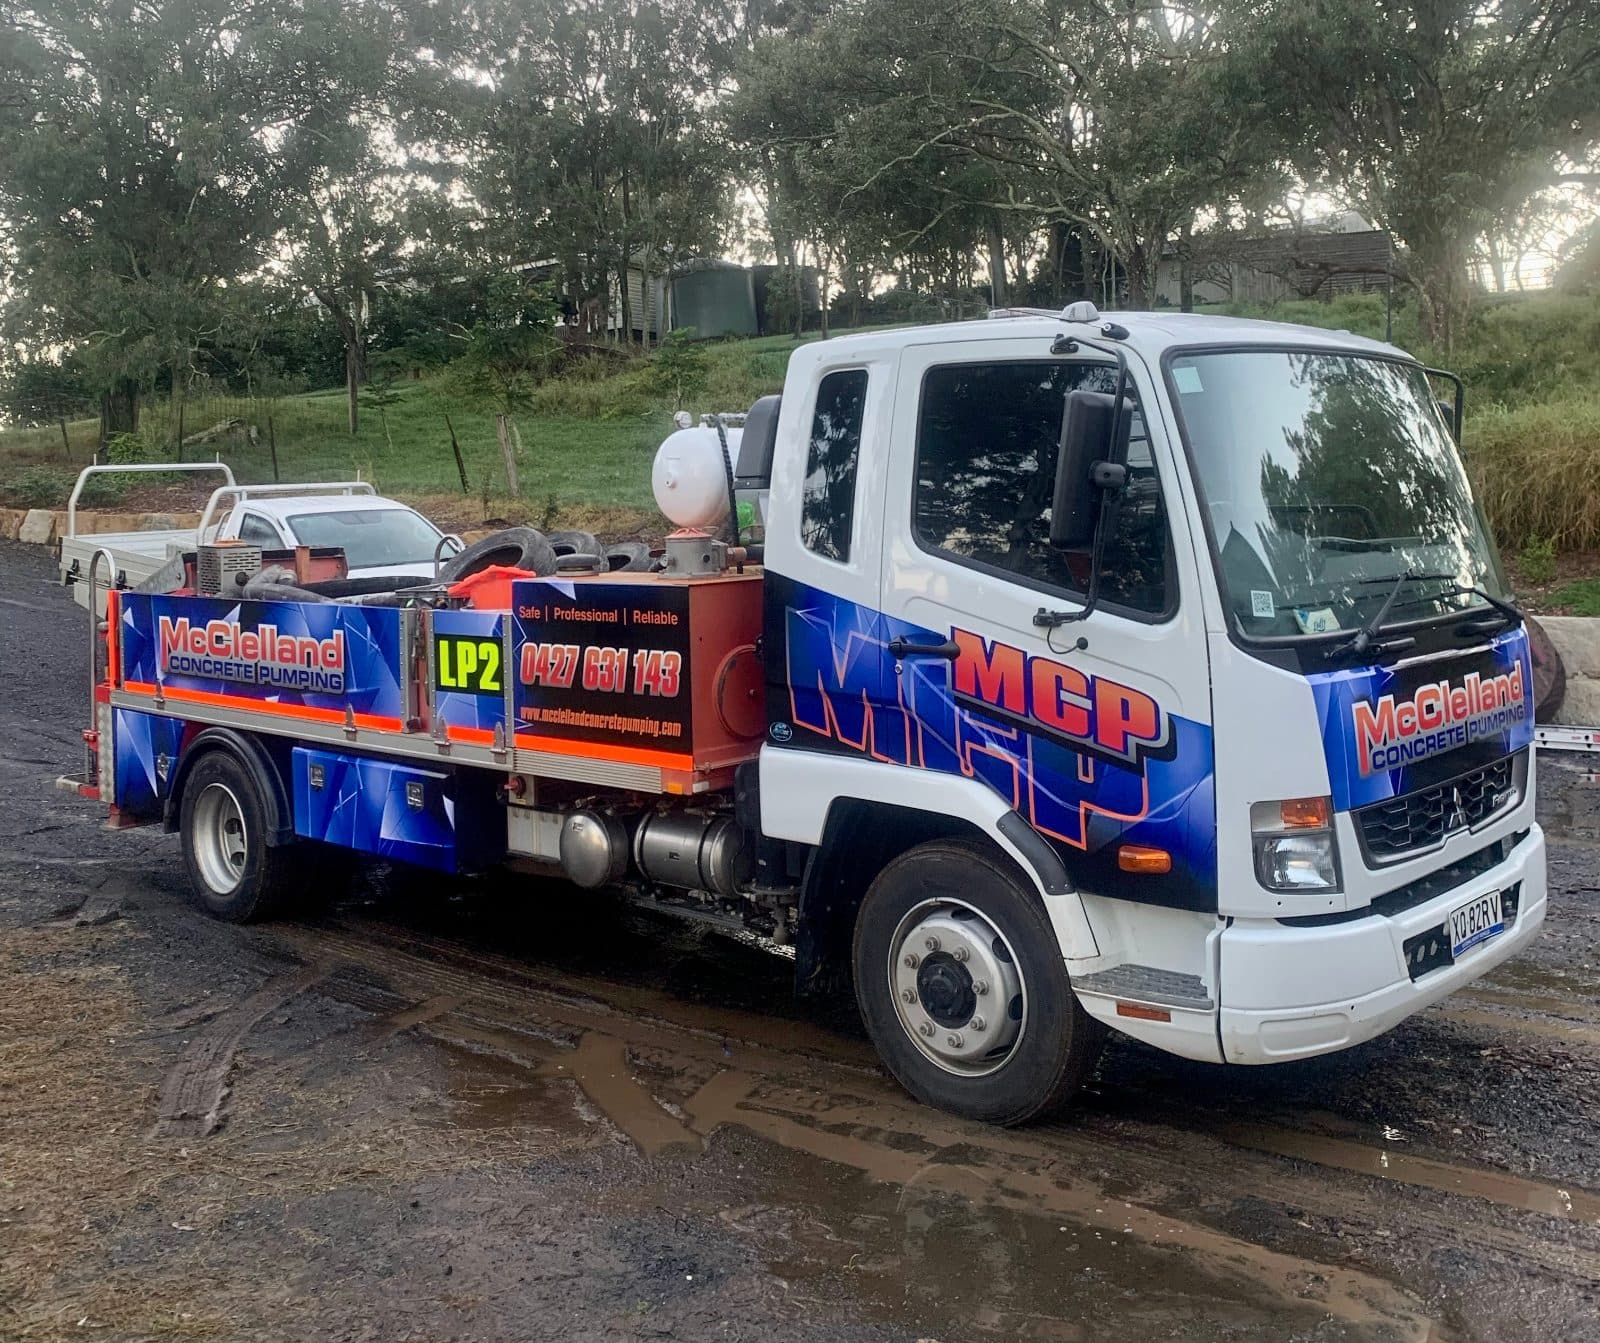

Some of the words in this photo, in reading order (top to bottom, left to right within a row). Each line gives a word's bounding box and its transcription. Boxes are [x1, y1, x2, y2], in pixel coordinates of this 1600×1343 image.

[519, 606, 541, 619] Safe
[554, 607, 618, 623] Professional
[633, 610, 679, 625] Reliable
[159, 616, 345, 672] McClelland
[439, 640, 500, 691] LP2
[520, 642, 580, 688] 0427
[583, 646, 628, 693] 631
[634, 649, 681, 697] 143
[169, 655, 254, 679] CONCRETE
[259, 666, 342, 691] PUMPING
[950, 626, 1162, 755] MCP
[520, 707, 682, 737] www.mcclellandconcretepumping.com
[1352, 661, 1524, 778] McClelland
[1372, 725, 1465, 770] CONCRETE
[1469, 705, 1524, 737] PUMPING
